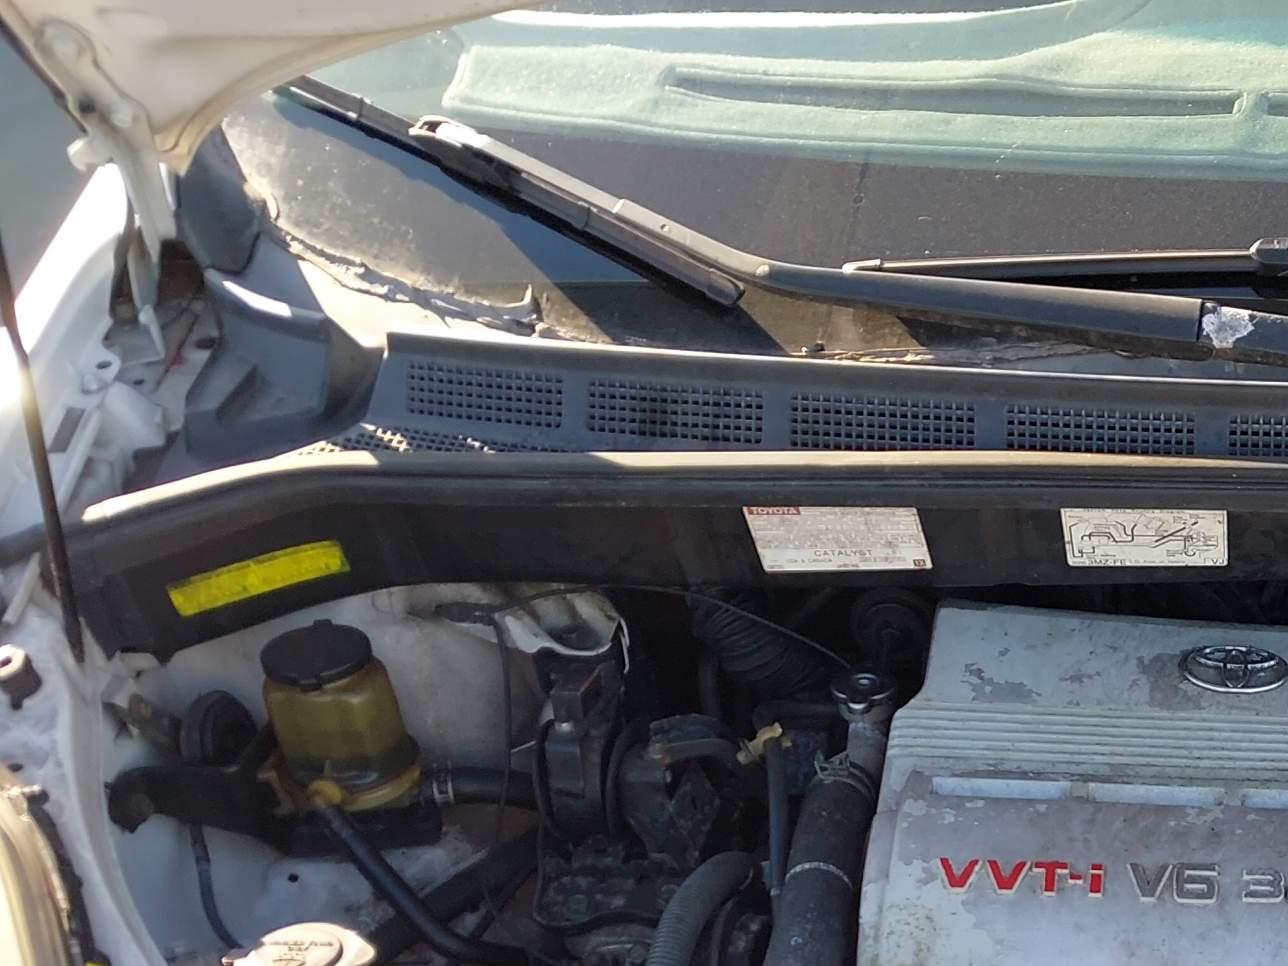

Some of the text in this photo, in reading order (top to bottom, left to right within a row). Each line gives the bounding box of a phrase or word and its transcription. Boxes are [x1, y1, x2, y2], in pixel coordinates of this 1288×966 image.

[751, 507, 799, 515] TOYOTA
[814, 549, 873, 557] CATALYST
[938, 856, 1105, 897] VVT-i
[1128, 861, 1222, 904] V6
